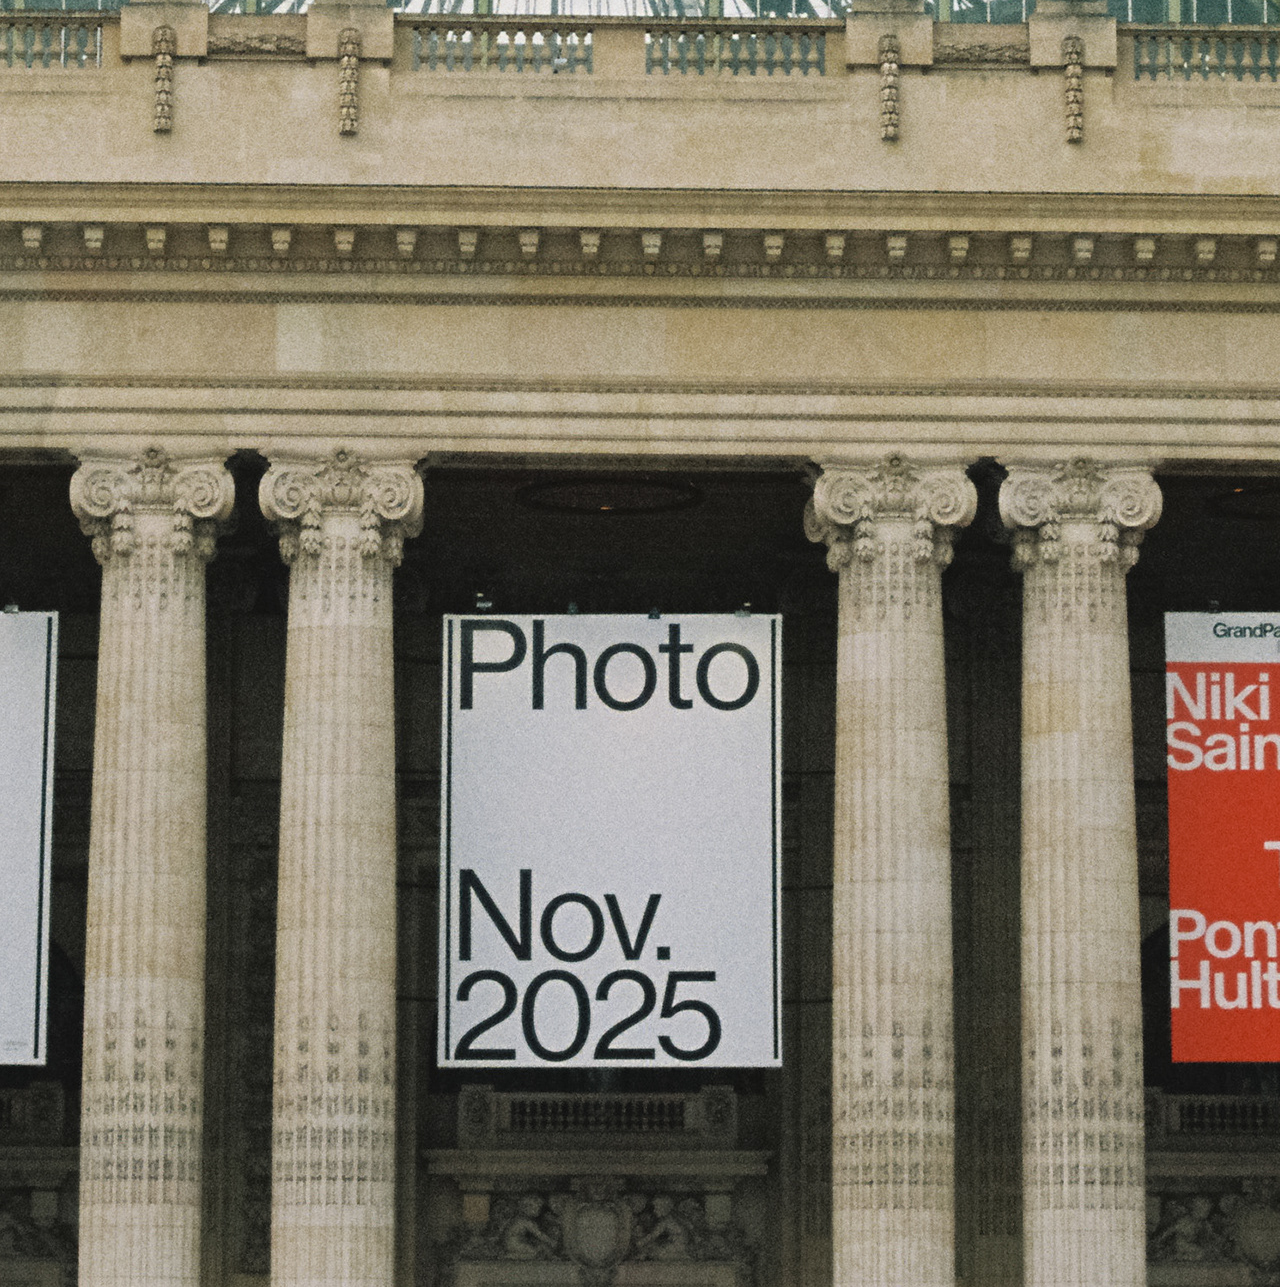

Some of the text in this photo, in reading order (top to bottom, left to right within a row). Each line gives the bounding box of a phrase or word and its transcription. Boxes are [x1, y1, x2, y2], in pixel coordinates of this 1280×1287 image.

[460, 619, 760, 711] Photo
[1166, 672, 1270, 720] Niki
[458, 869, 671, 962] Nov.
[454, 969, 721, 1062] 2025
